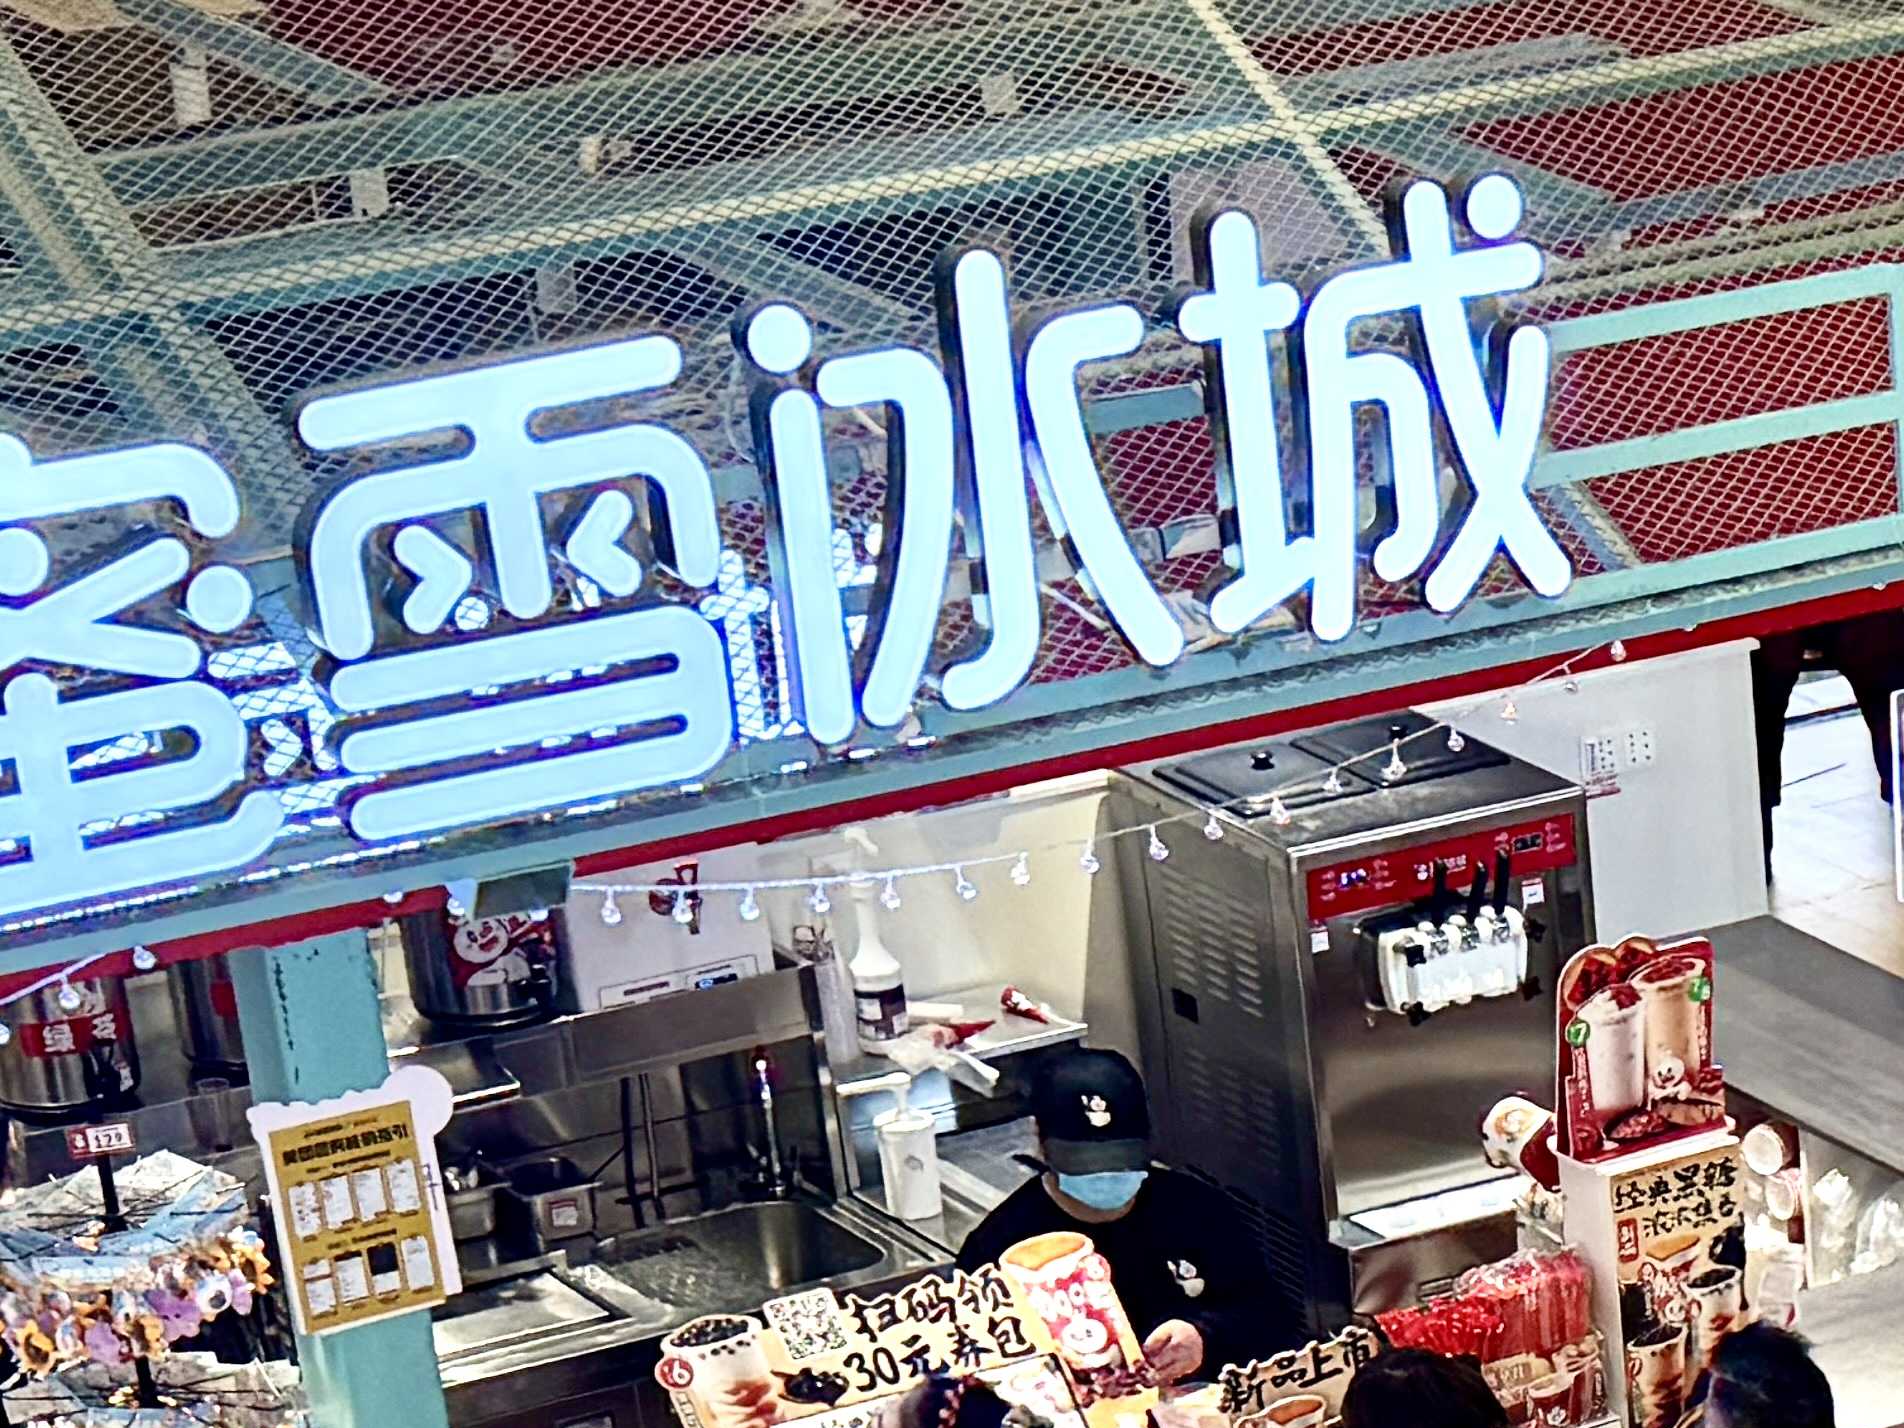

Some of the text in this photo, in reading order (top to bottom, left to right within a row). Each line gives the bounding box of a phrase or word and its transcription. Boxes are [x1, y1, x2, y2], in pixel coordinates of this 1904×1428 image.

[851, 1265, 1014, 1342] 扫码领
[1221, 1337, 1371, 1413] 新品上市
